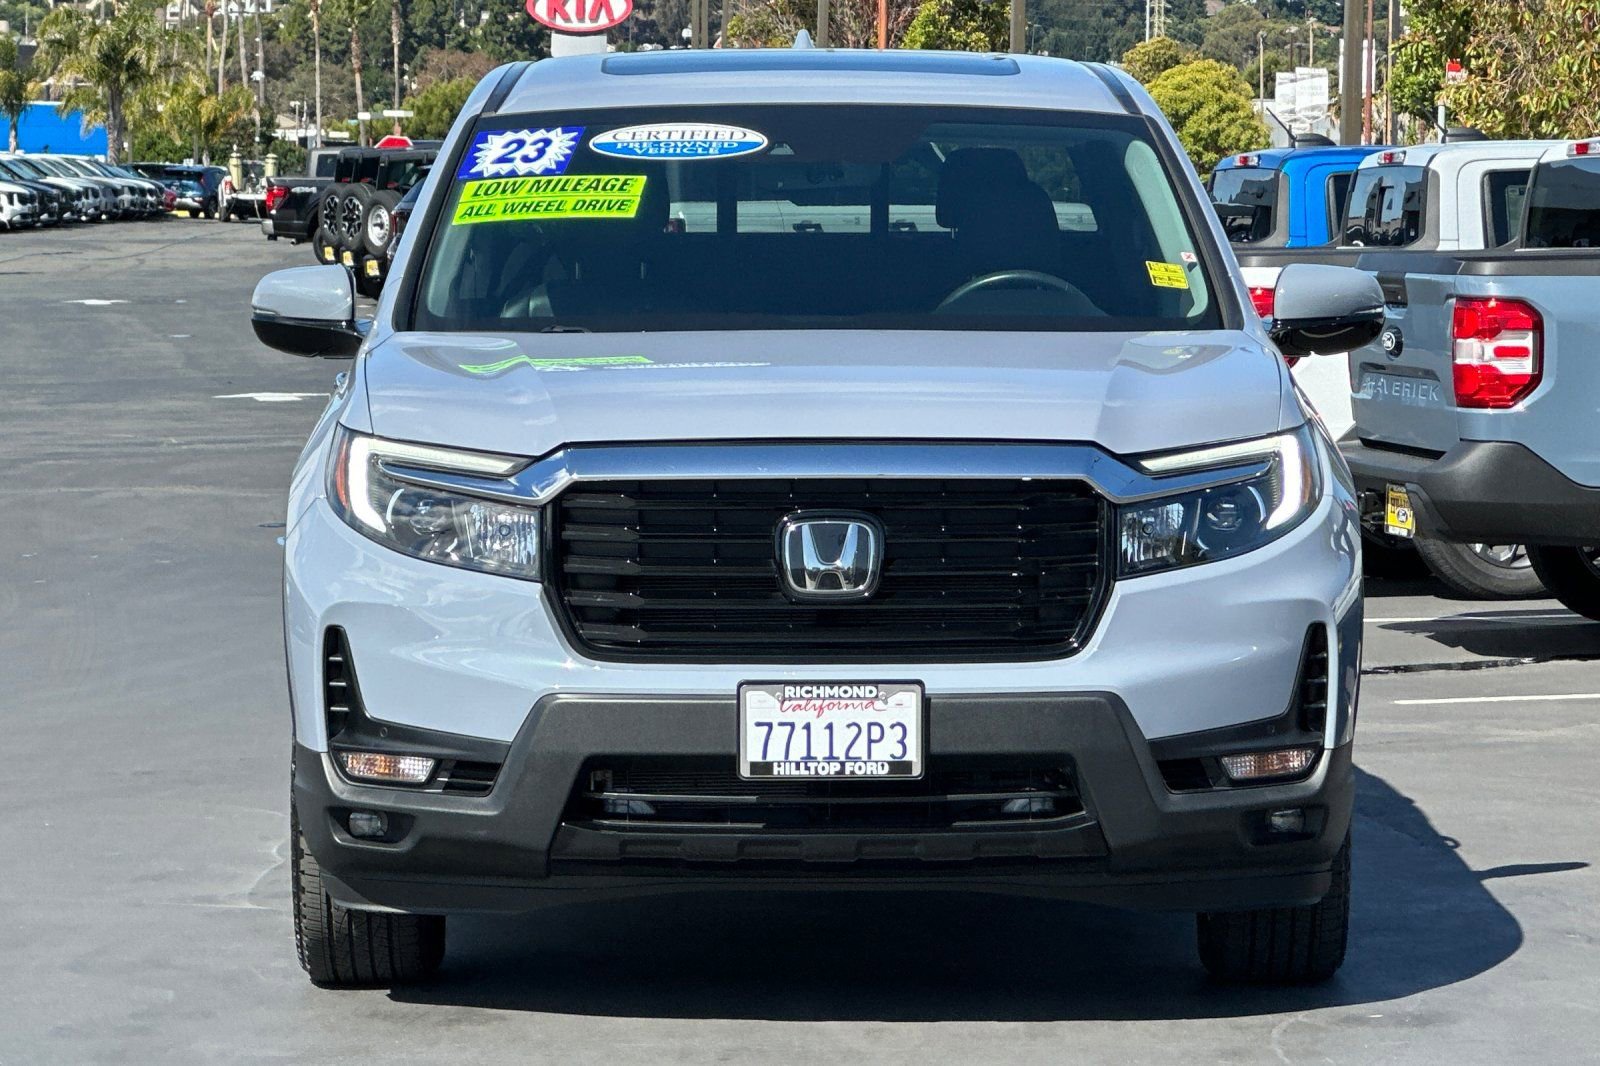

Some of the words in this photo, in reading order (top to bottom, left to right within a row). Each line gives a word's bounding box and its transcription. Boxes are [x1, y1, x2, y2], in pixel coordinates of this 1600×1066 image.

[547, 0, 615, 23] KIA
[612, 129, 747, 141] CERTIFIED
[491, 137, 552, 163] 23
[616, 141, 739, 150] PRE-OWNED
[633, 147, 719, 155] VEHICLE
[472, 178, 524, 197] LOW
[527, 176, 633, 193] MILEAGE
[460, 204, 496, 218] ALL
[502, 200, 566, 214] WHEEL
[571, 199, 635, 213] DRIVE
[784, 685, 878, 699] RICHMOND
[779, 697, 887, 719] California
[754, 721, 908, 761] 77112P3
[773, 761, 841, 776] HILLTOP
[844, 761, 890, 776] FORD
